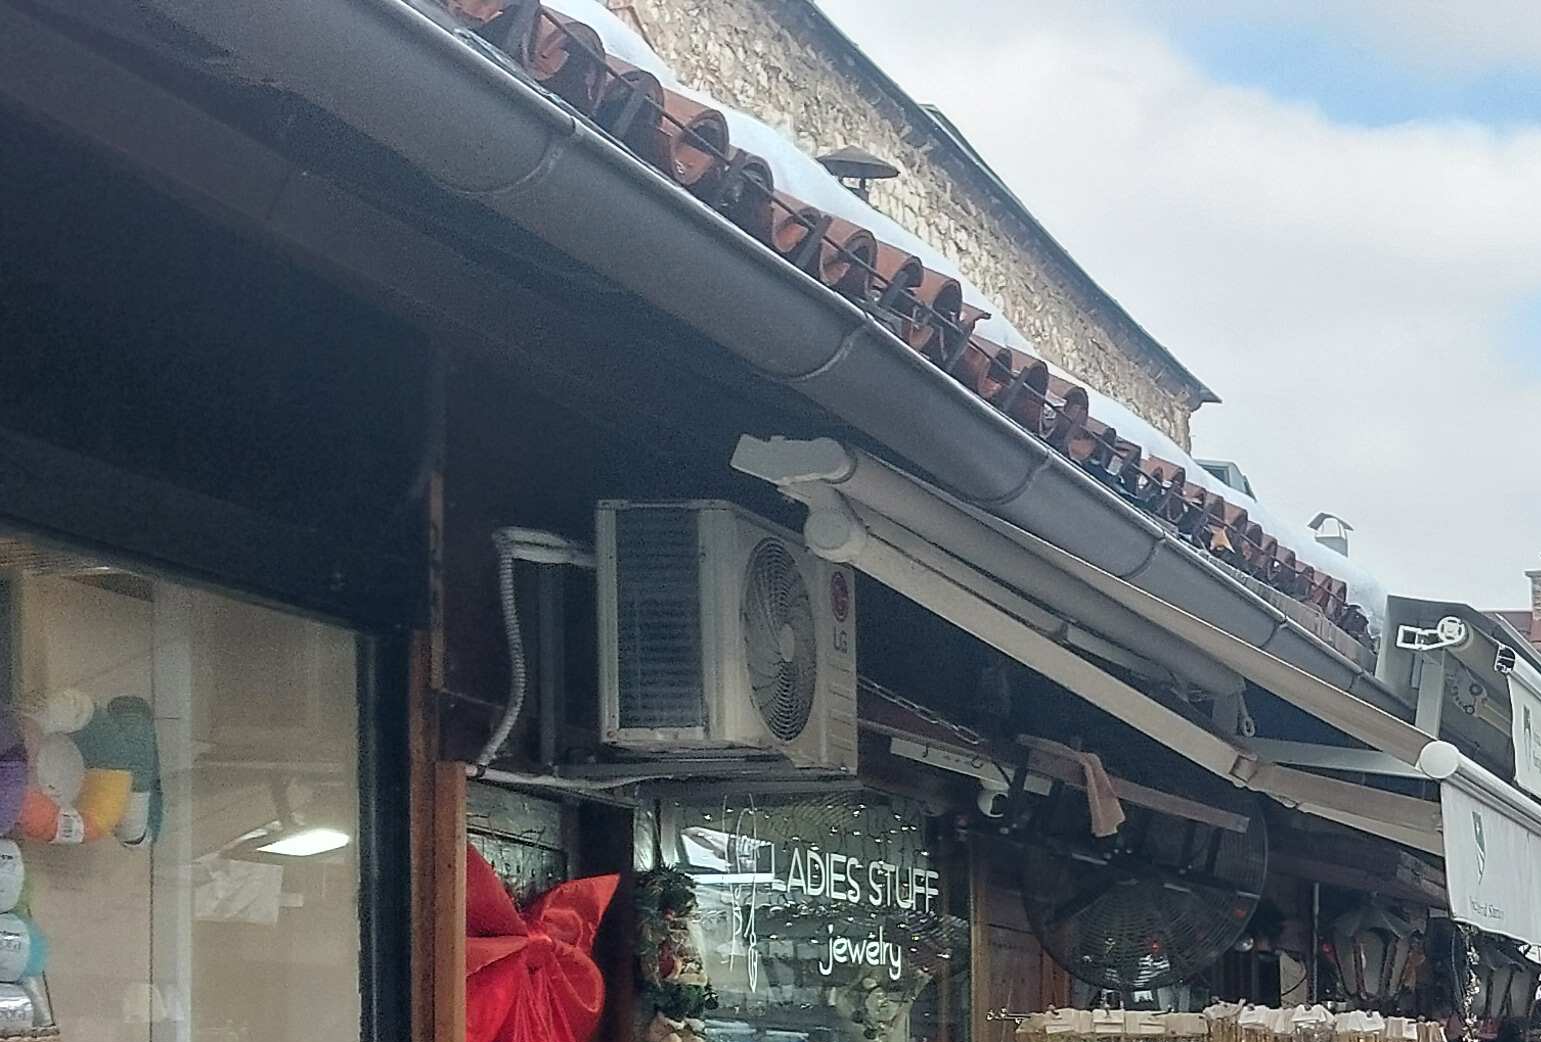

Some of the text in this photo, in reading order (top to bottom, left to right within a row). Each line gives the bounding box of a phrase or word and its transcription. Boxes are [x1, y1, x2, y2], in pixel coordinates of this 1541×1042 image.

[833, 624, 848, 655] LG
[771, 844, 940, 913] LADIES STUFF
[818, 923, 902, 981] jewelry
